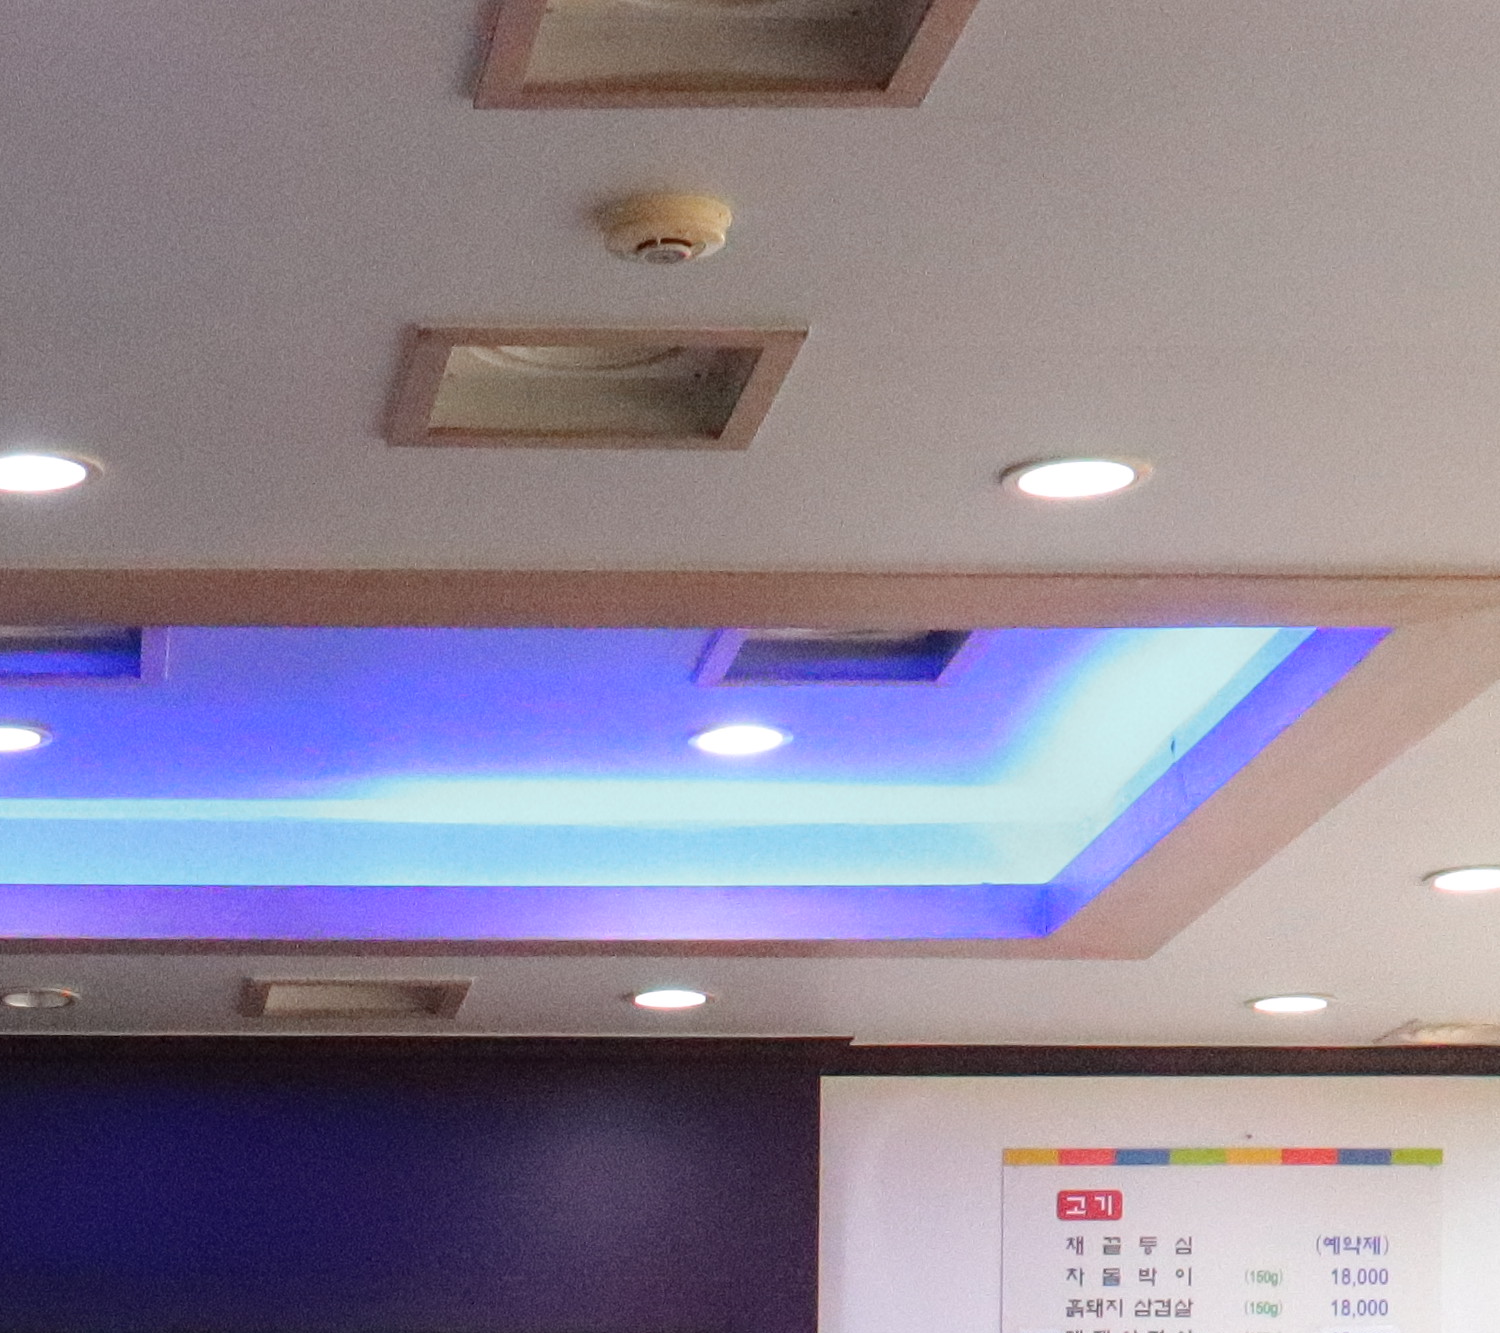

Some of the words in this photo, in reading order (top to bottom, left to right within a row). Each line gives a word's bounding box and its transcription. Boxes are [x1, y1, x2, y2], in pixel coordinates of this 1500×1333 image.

[1065, 1195, 1113, 1216] 고기
[1316, 1236, 1388, 1255] (예약제)
[1245, 1270, 1282, 1287] (150g)
[1332, 1268, 1388, 1286] 18,000
[1134, 1299, 1193, 1317] 삼겹살
[1245, 1301, 1282, 1318] (150g)
[1332, 1299, 1388, 1317] 18,000
